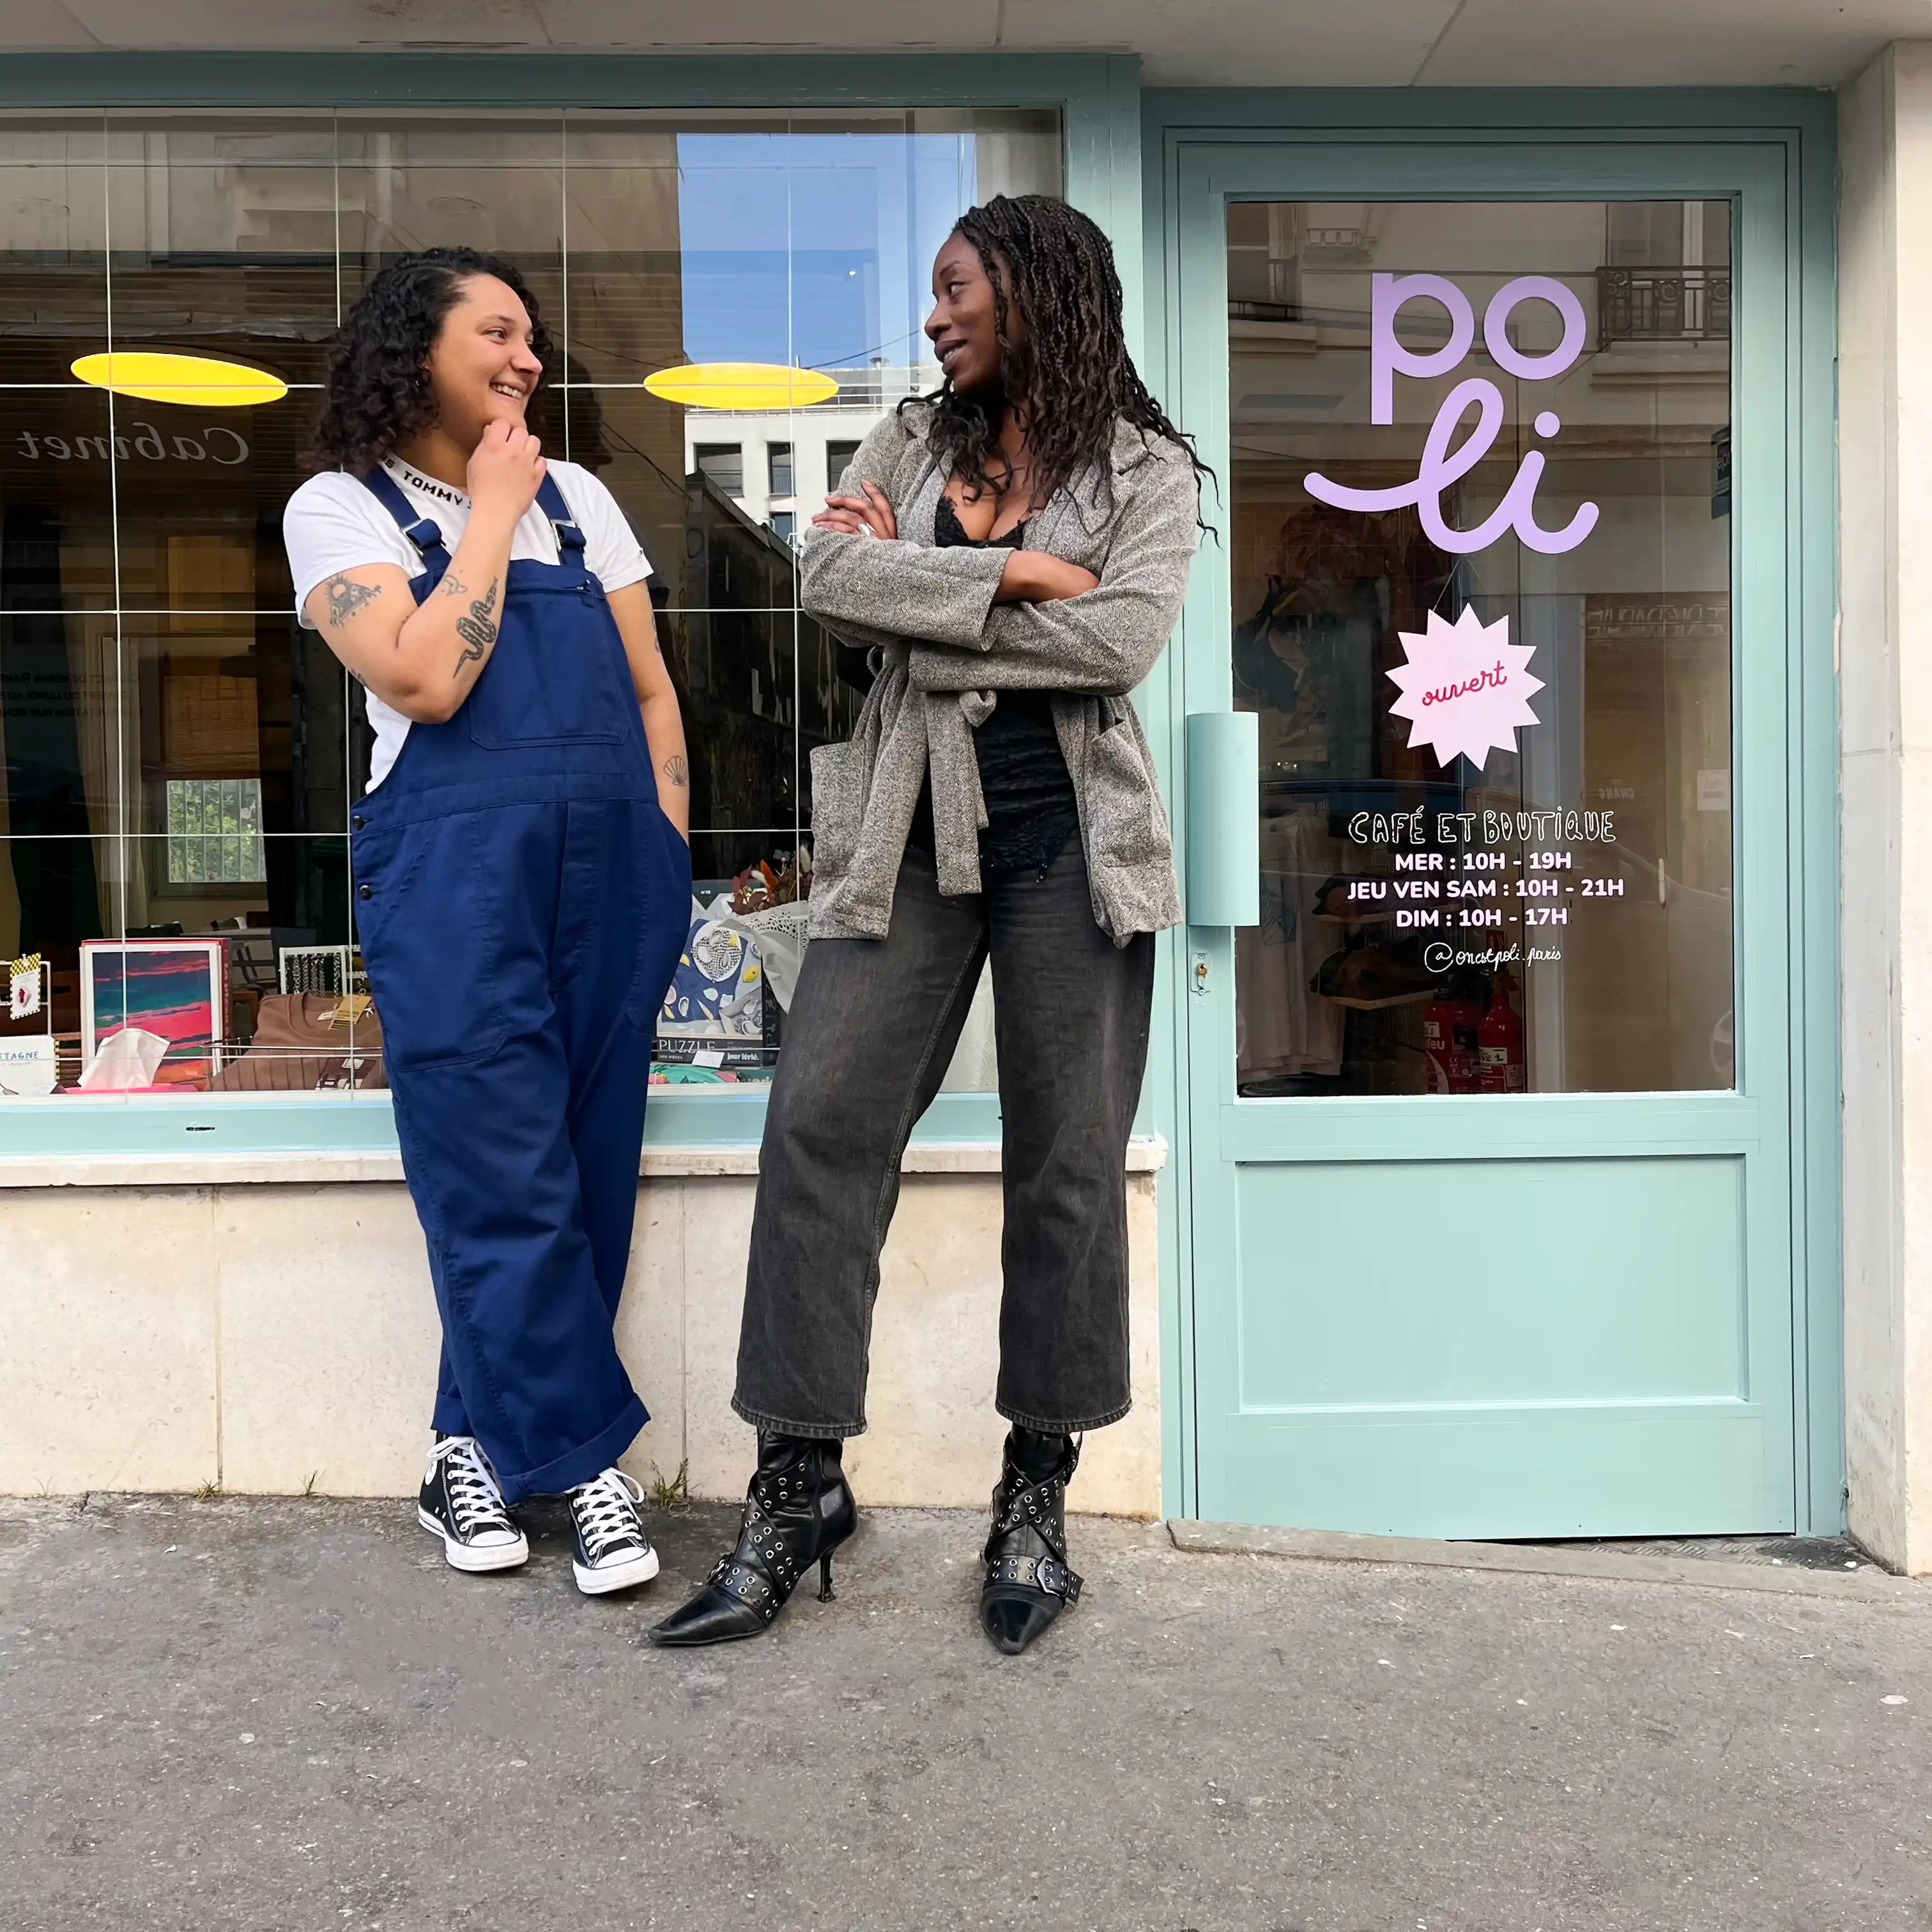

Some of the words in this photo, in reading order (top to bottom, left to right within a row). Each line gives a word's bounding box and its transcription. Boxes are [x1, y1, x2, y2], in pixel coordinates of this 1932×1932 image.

[403, 471, 463, 505] TOMMY
[1422, 661, 1507, 706] ouvert
[1349, 805, 1425, 845] CAFÉ
[1437, 813, 1477, 843] ET
[1395, 853, 1443, 871] MER
[1463, 852, 1505, 870] 10H
[1529, 852, 1572, 870] 19H
[1347, 882, 1386, 900] JEU
[1393, 880, 1439, 898] VEN
[1446, 879, 1496, 898] SAM
[1515, 879, 1558, 897] 10H
[1581, 878, 1624, 896] 21H
[1396, 909, 1439, 927] DIM
[1459, 908, 1501, 926] 10H
[1525, 907, 1567, 925] 17H
[659, 1039, 716, 1054] PUZZLE
[727, 1052, 741, 1061] jour
